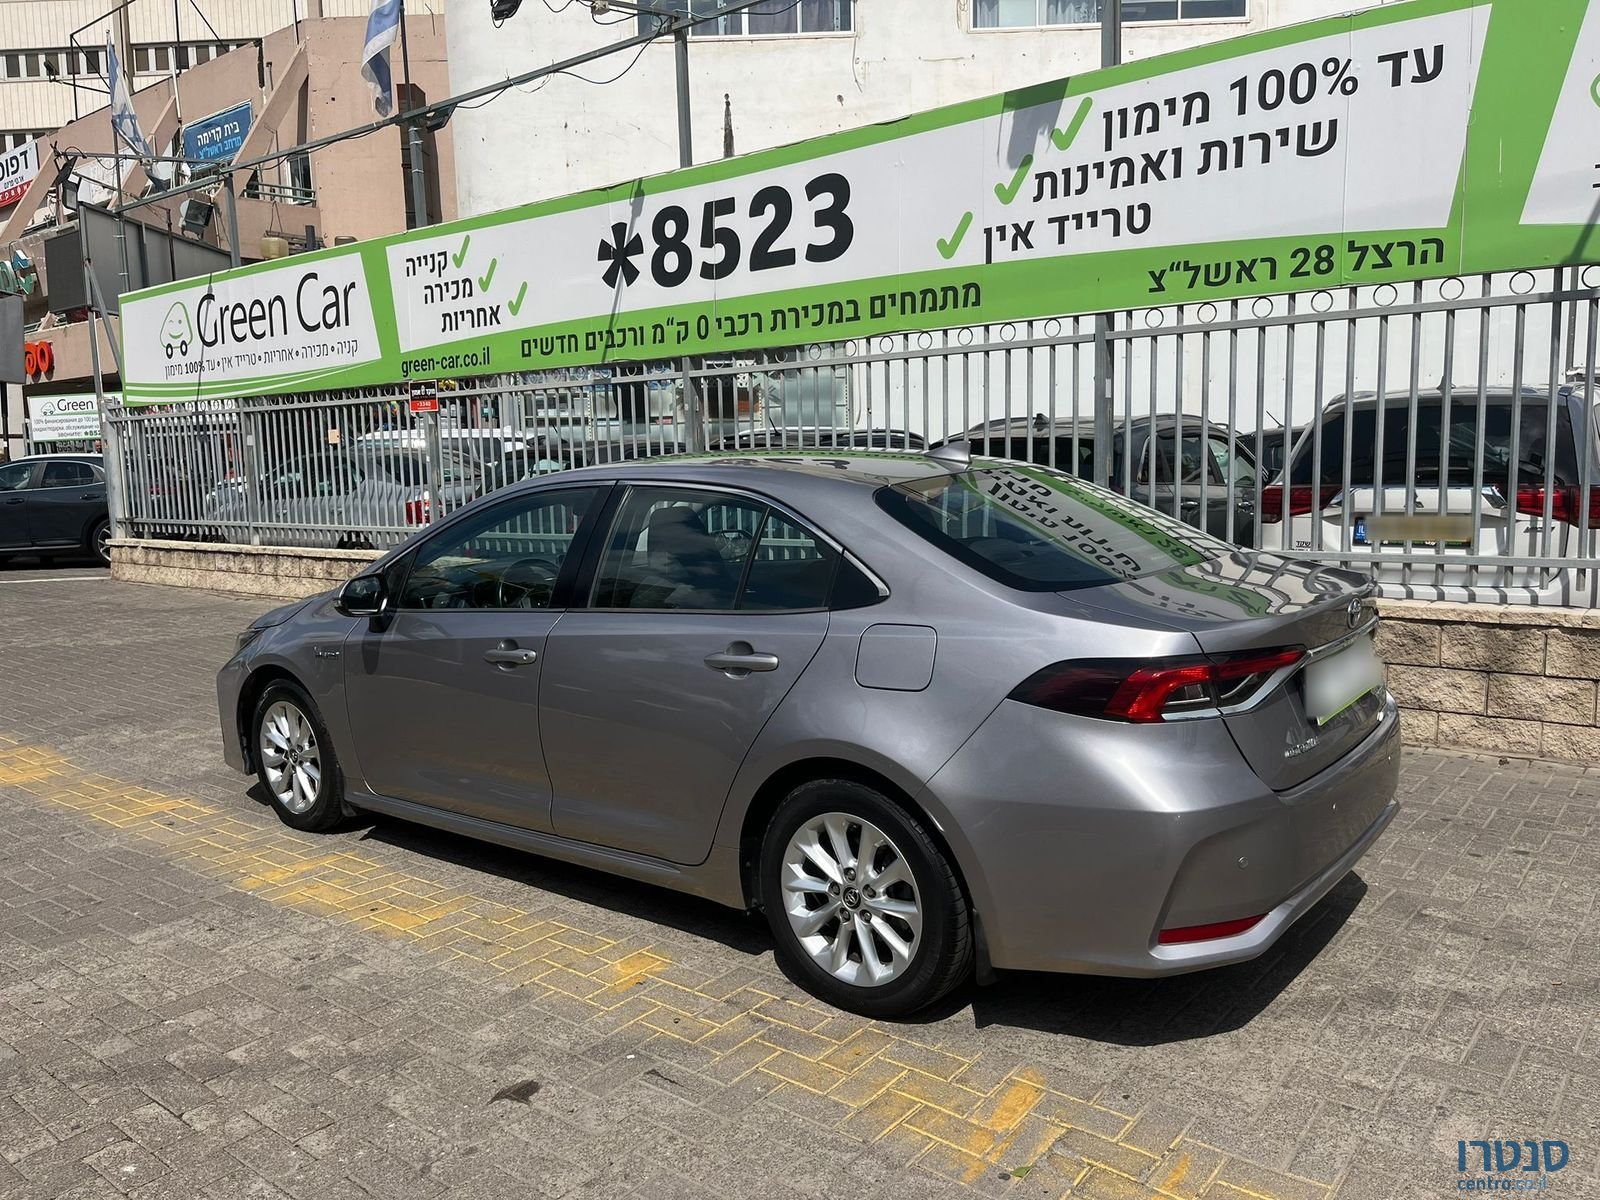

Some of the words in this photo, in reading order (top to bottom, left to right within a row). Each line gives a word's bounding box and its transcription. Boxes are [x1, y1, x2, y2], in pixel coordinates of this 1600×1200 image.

[1377, 44, 1444, 88] עד
[1229, 57, 1359, 116] 100%
[224, 121, 240, 137] בית
[1102, 92, 1210, 152] מימון
[197, 126, 222, 147] קדימה
[1198, 118, 1339, 175] שירות
[1032, 146, 1183, 203] ואמינות
[1047, 202, 1152, 246] טרייד
[983, 220, 1035, 265] אין
[1347, 236, 1445, 272] הרצל
[405, 250, 448, 278] קנייה
[1289, 245, 1335, 277] 28
[424, 276, 473, 304] מכירה
[869, 281, 982, 318] מתמחים
[196, 293, 288, 348] Green
[296, 272, 357, 332] Car
[441, 304, 501, 333] אחריות
[771, 299, 861, 331] במכירת
[585, 326, 644, 352] ורכבים
[696, 314, 709, 340] 0
[715, 312, 764, 338] רכבי
[234, 352, 257, 367] טרייד
[264, 348, 294, 364] אחריות
[301, 343, 329, 359] מכירה
[337, 339, 358, 357] קניה
[521, 334, 579, 358] חדשים
[165, 364, 183, 380] מימון
[185, 361, 206, 374] 100%
[206, 359, 216, 371] עד
[221, 357, 233, 373] אין
[401, 346, 490, 378] green-car.co.il
[57, 399, 94, 411] Green
